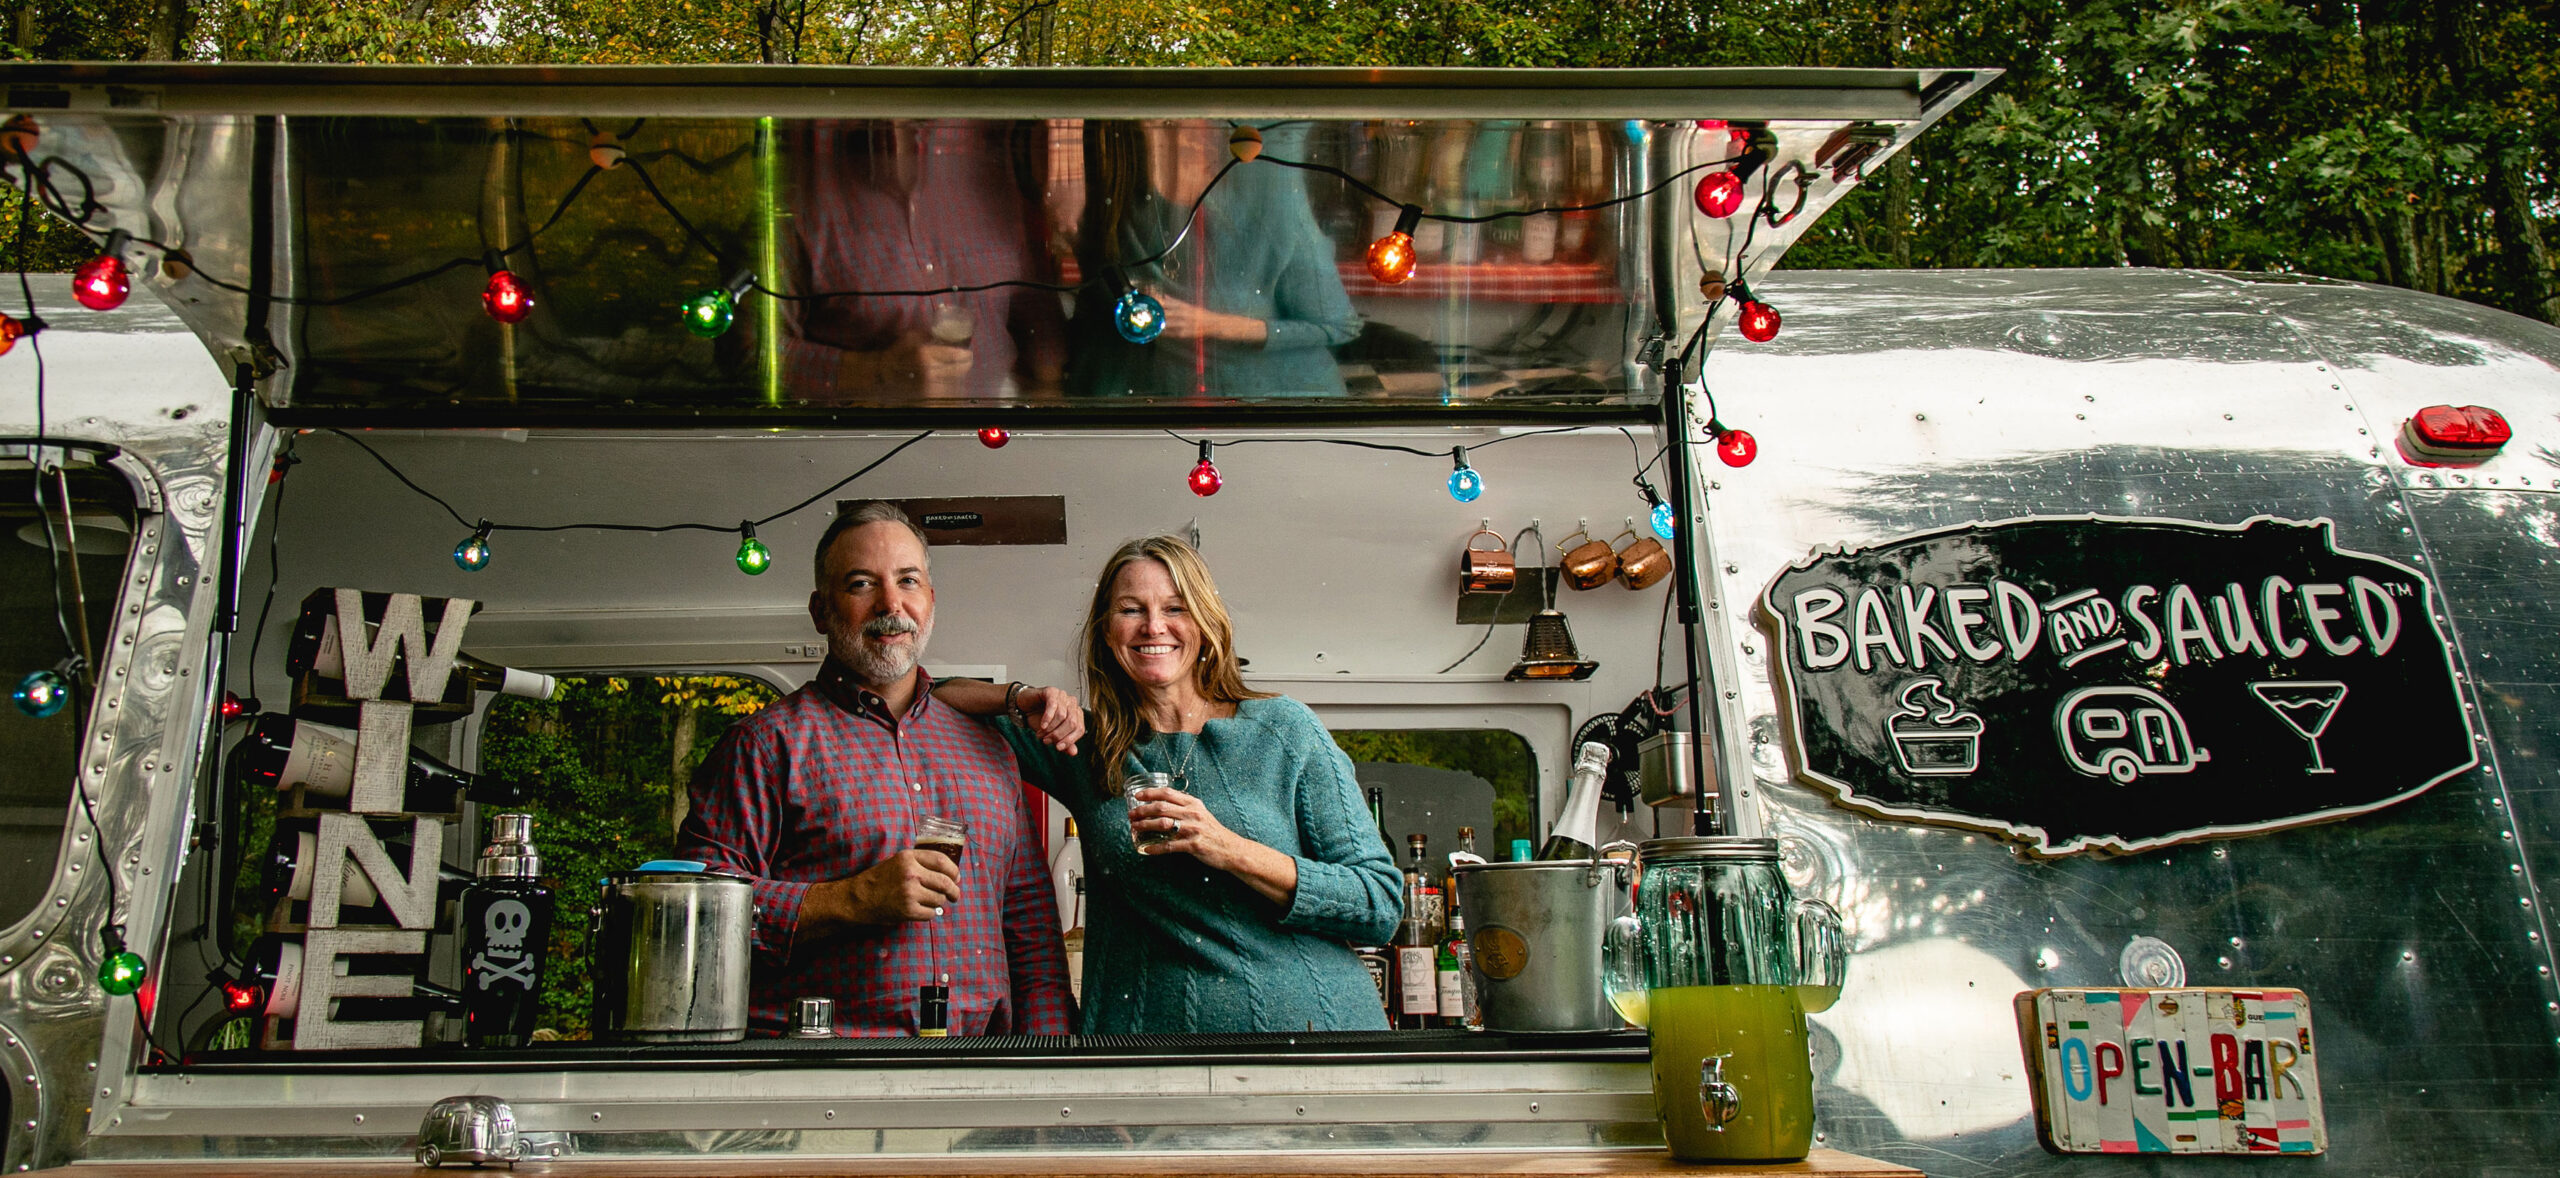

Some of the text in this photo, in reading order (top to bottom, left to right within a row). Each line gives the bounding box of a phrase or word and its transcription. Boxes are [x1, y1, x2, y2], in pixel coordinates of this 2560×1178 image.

[1794, 580, 2042, 671] BAKED
[2052, 598, 2120, 657] AND
[2127, 575, 2400, 666] SAUCED
[293, 587, 475, 1050] WINE
[2061, 1033, 2304, 1107] OPEN-BAR
